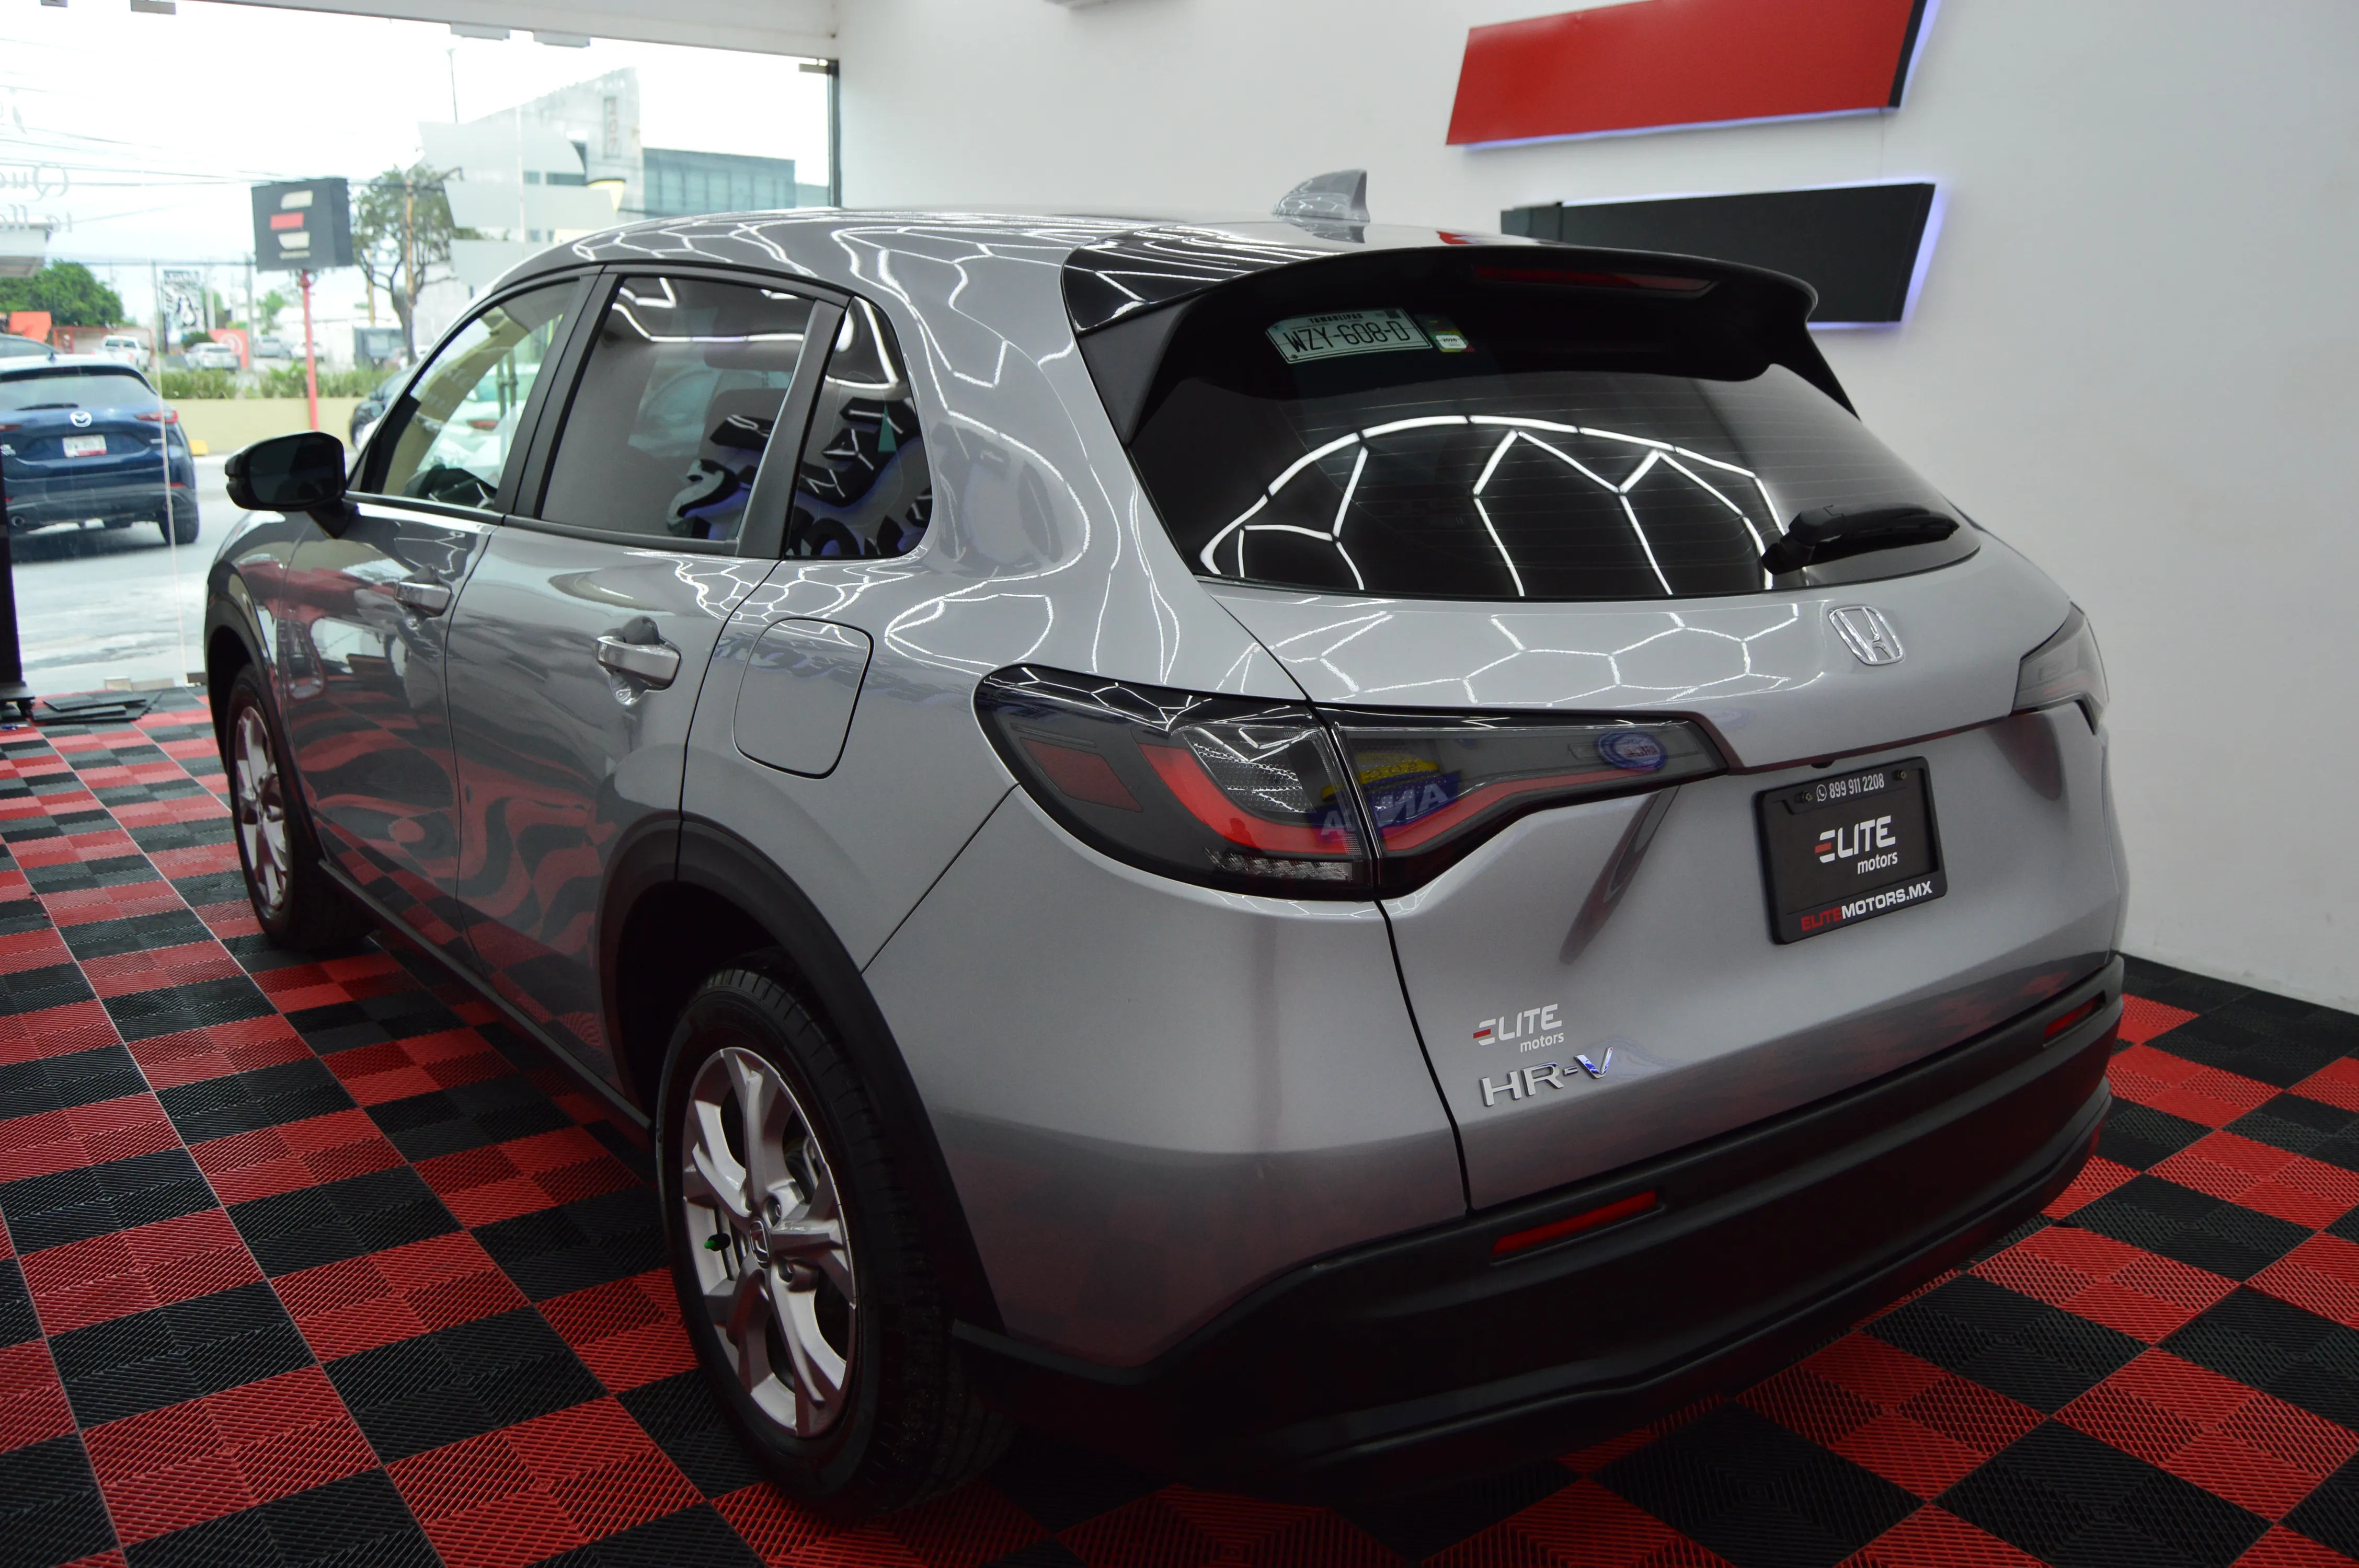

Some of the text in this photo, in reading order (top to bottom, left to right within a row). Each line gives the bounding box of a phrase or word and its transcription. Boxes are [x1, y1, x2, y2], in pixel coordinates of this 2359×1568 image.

[1309, 313, 1364, 324] TAMAULIPAS
[1282, 320, 1411, 353] WZY-608-D
[1829, 773, 1885, 799] 899 911 2208
[1814, 815, 1896, 863] ELITE
[1857, 851, 1898, 874] motors
[1801, 880, 1933, 931] ELITEMOTORS.MX
[1473, 1004, 1562, 1046] ELITE
[1520, 1032, 1565, 1053] motors
[1479, 1046, 1613, 1106] HR-V
